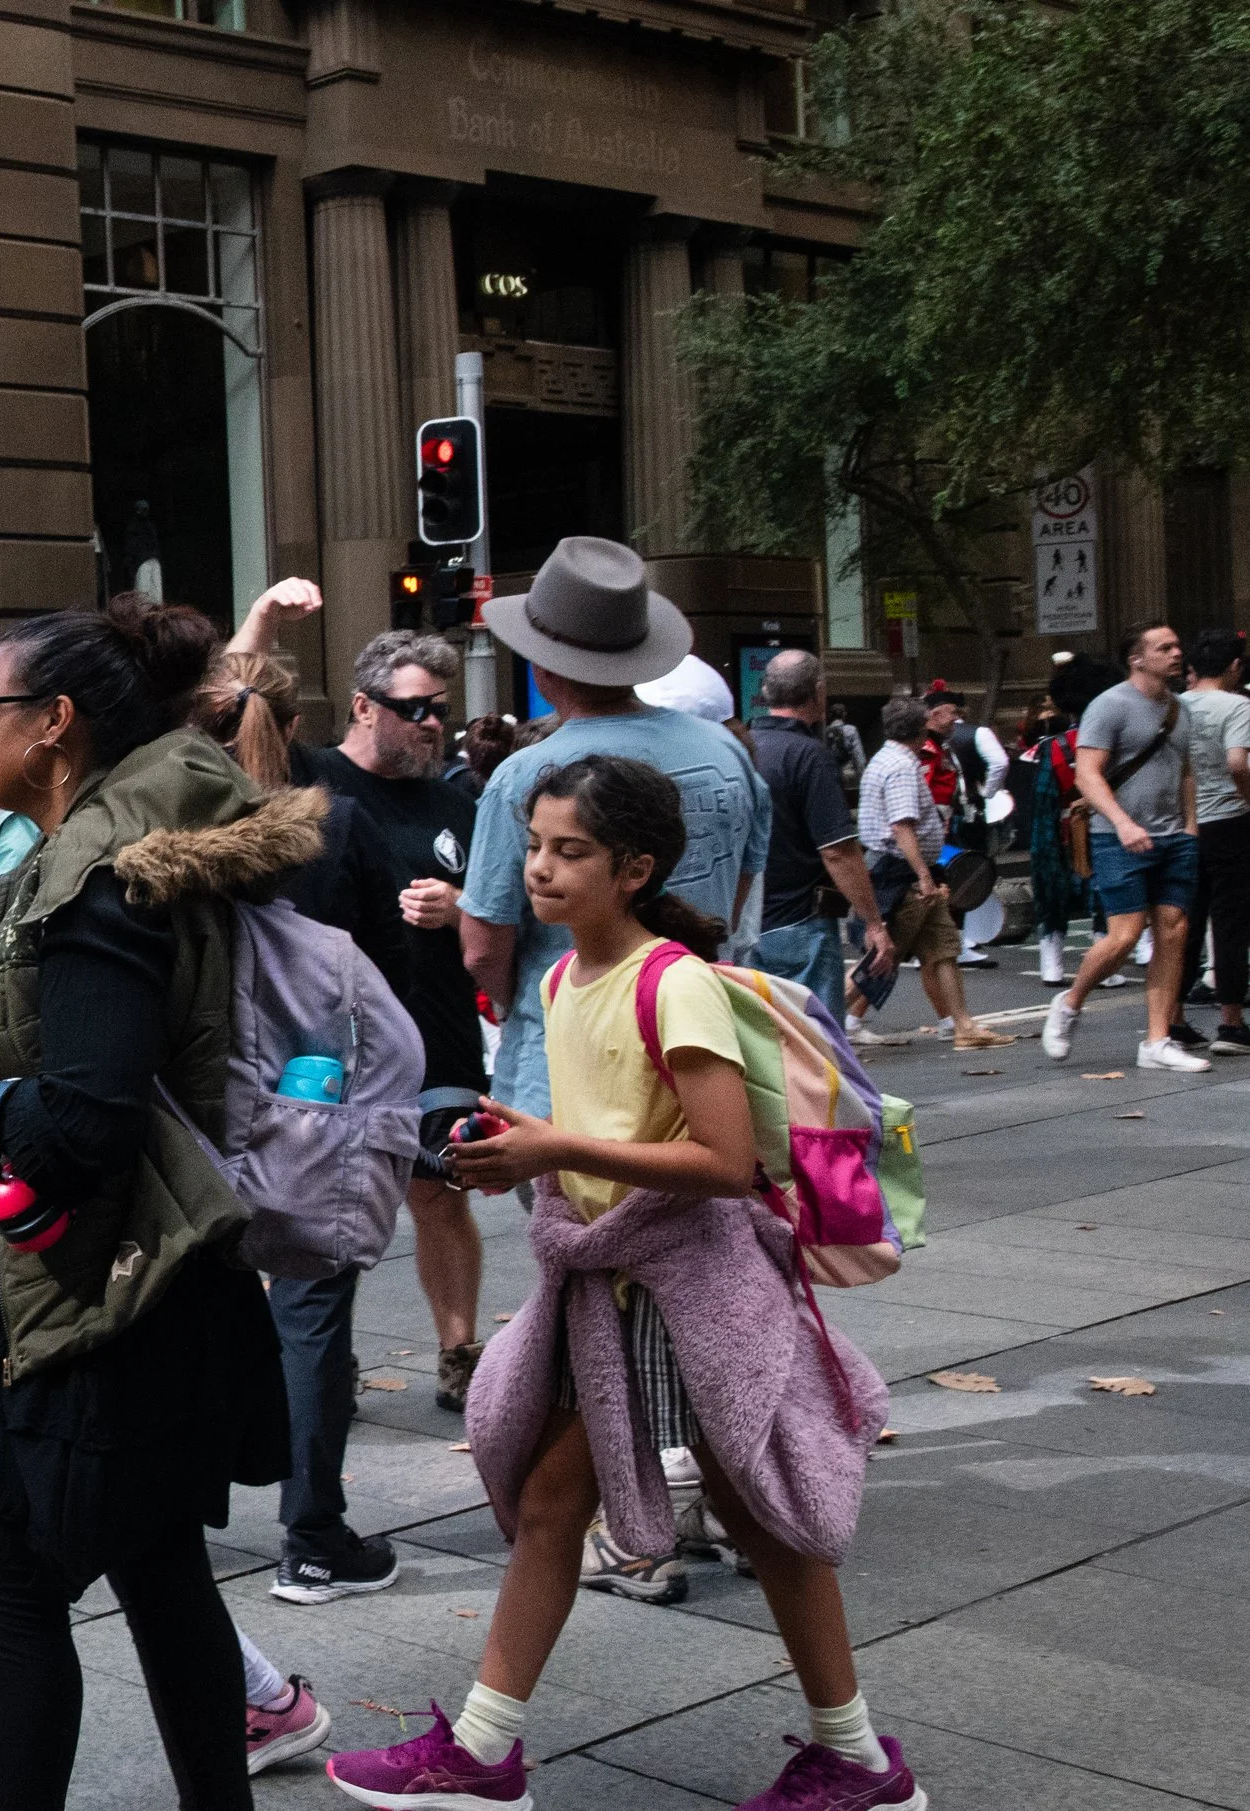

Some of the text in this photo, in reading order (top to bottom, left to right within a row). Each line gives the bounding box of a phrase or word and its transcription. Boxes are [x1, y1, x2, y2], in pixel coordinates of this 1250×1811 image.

[446, 96, 681, 176] Bank of Australia
[484, 272, 528, 297] COS
[1039, 520, 1090, 537] AREA
